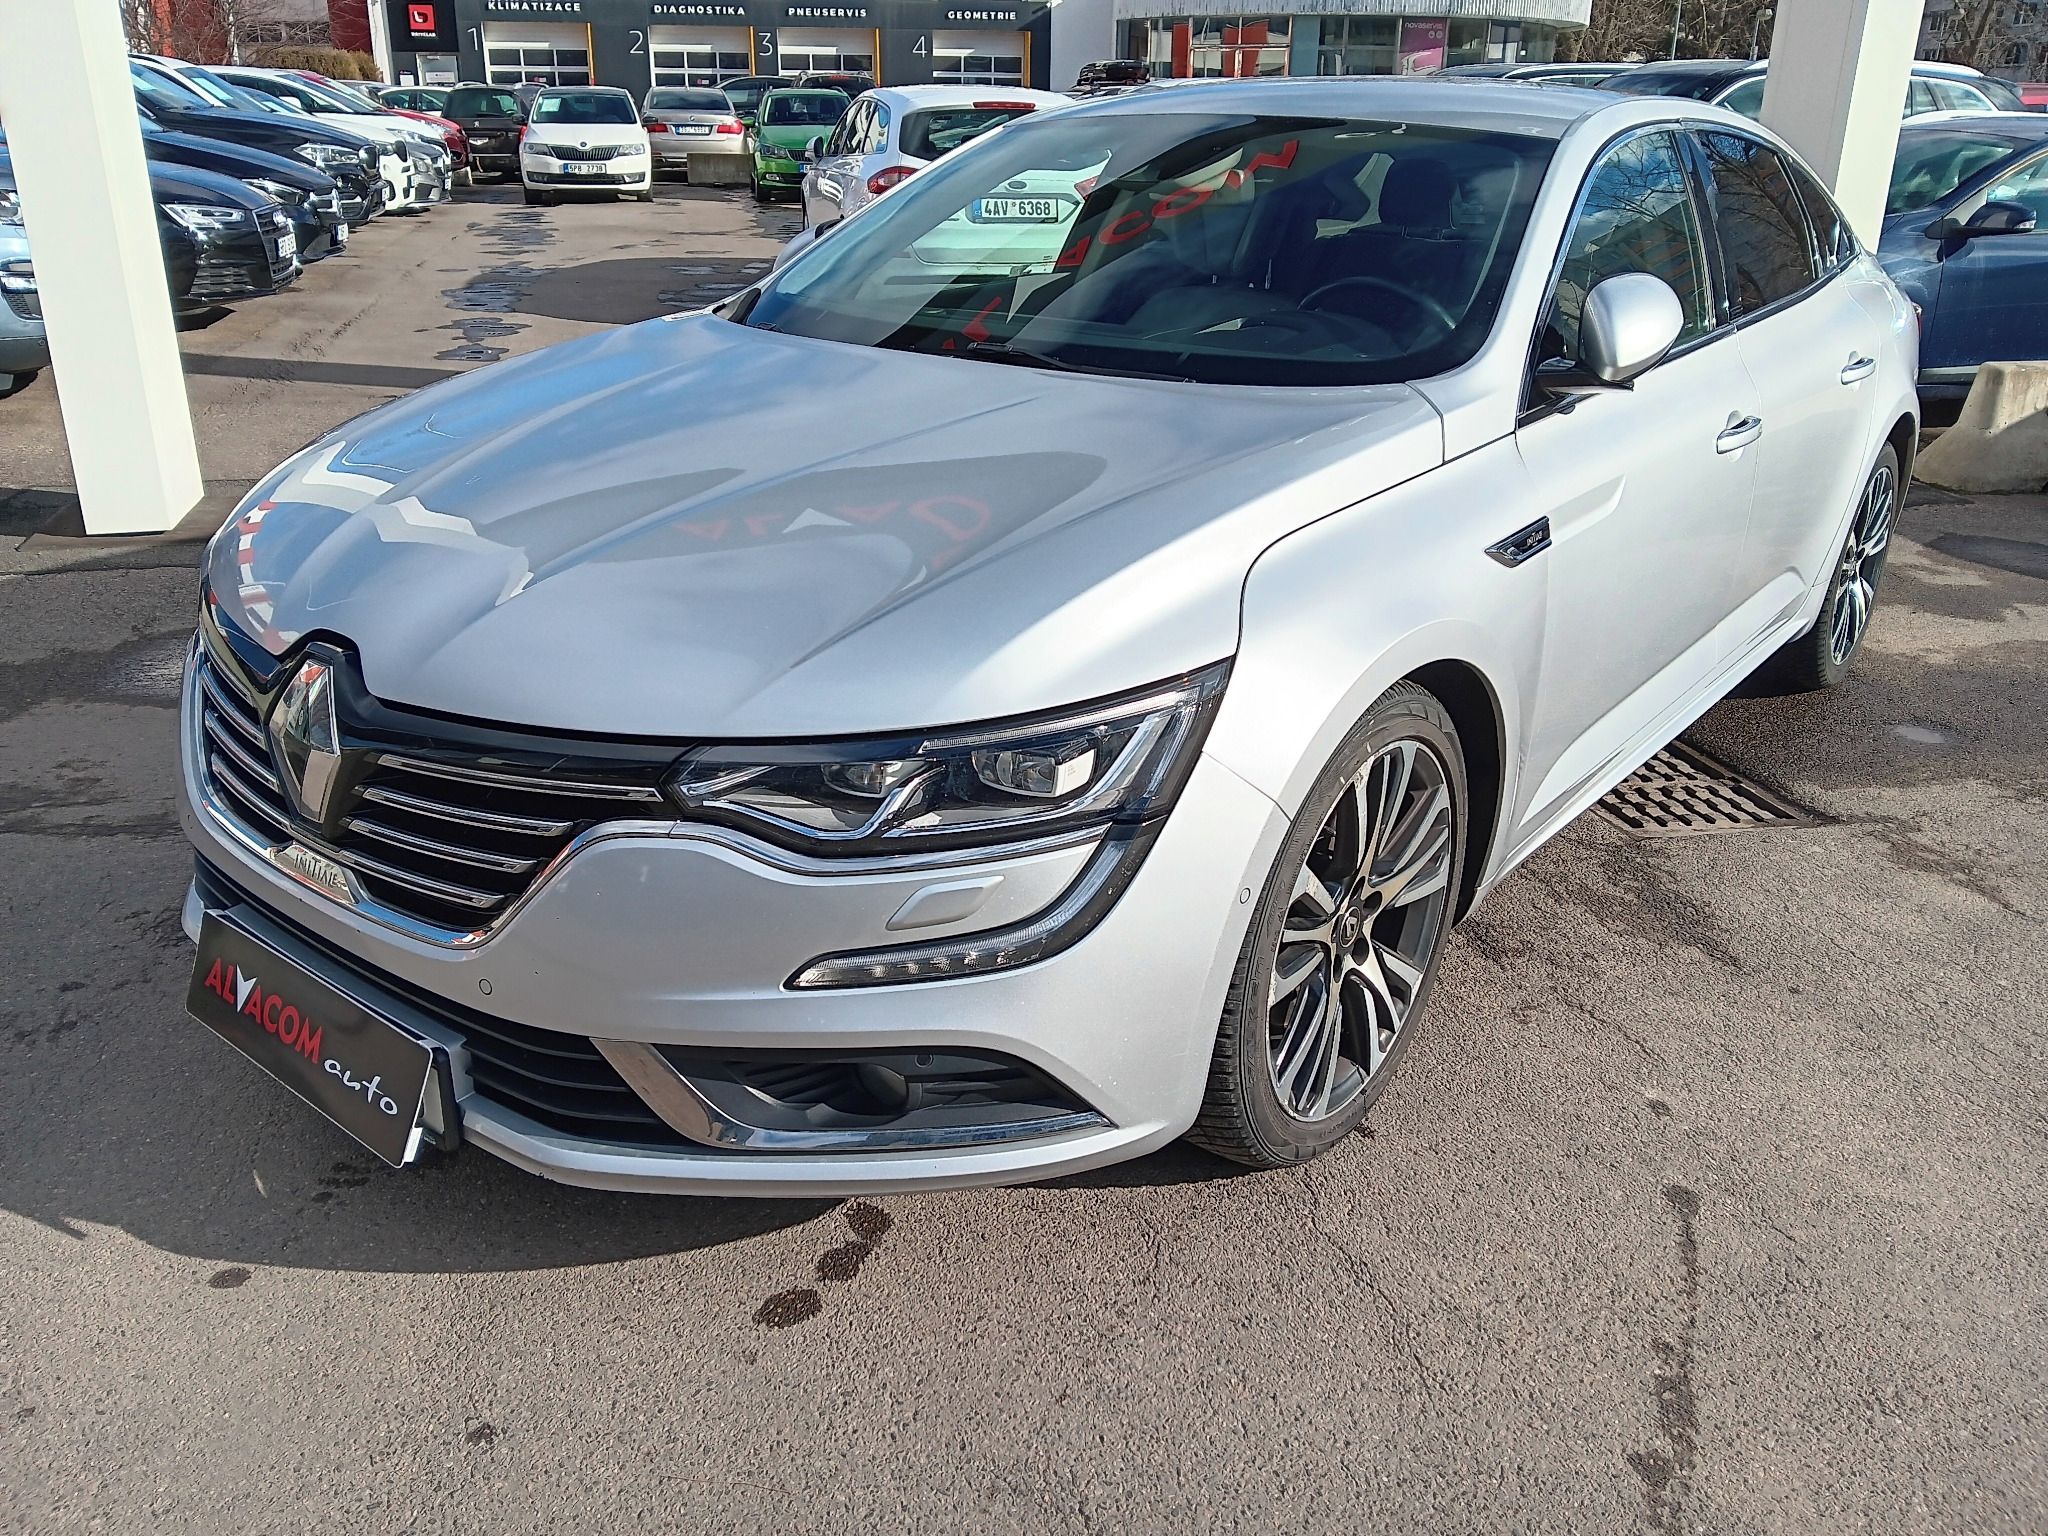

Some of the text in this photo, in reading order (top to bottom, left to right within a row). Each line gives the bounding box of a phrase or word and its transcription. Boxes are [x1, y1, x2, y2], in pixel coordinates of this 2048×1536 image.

[487, 1, 581, 11] KLIMATIZACE
[653, 5, 746, 16] DIAGNOSTIKA
[788, 7, 867, 17] PNEUSERVIS
[947, 10, 1017, 20] GEOMETRIE
[467, 27, 478, 51] 1
[628, 31, 645, 54] 2
[758, 32, 773, 56] 3
[912, 35, 928, 58] 4
[984, 200, 1009, 216] 4AV
[1018, 200, 1051, 216] 6368
[204, 957, 399, 1116] ALVACOM auto
